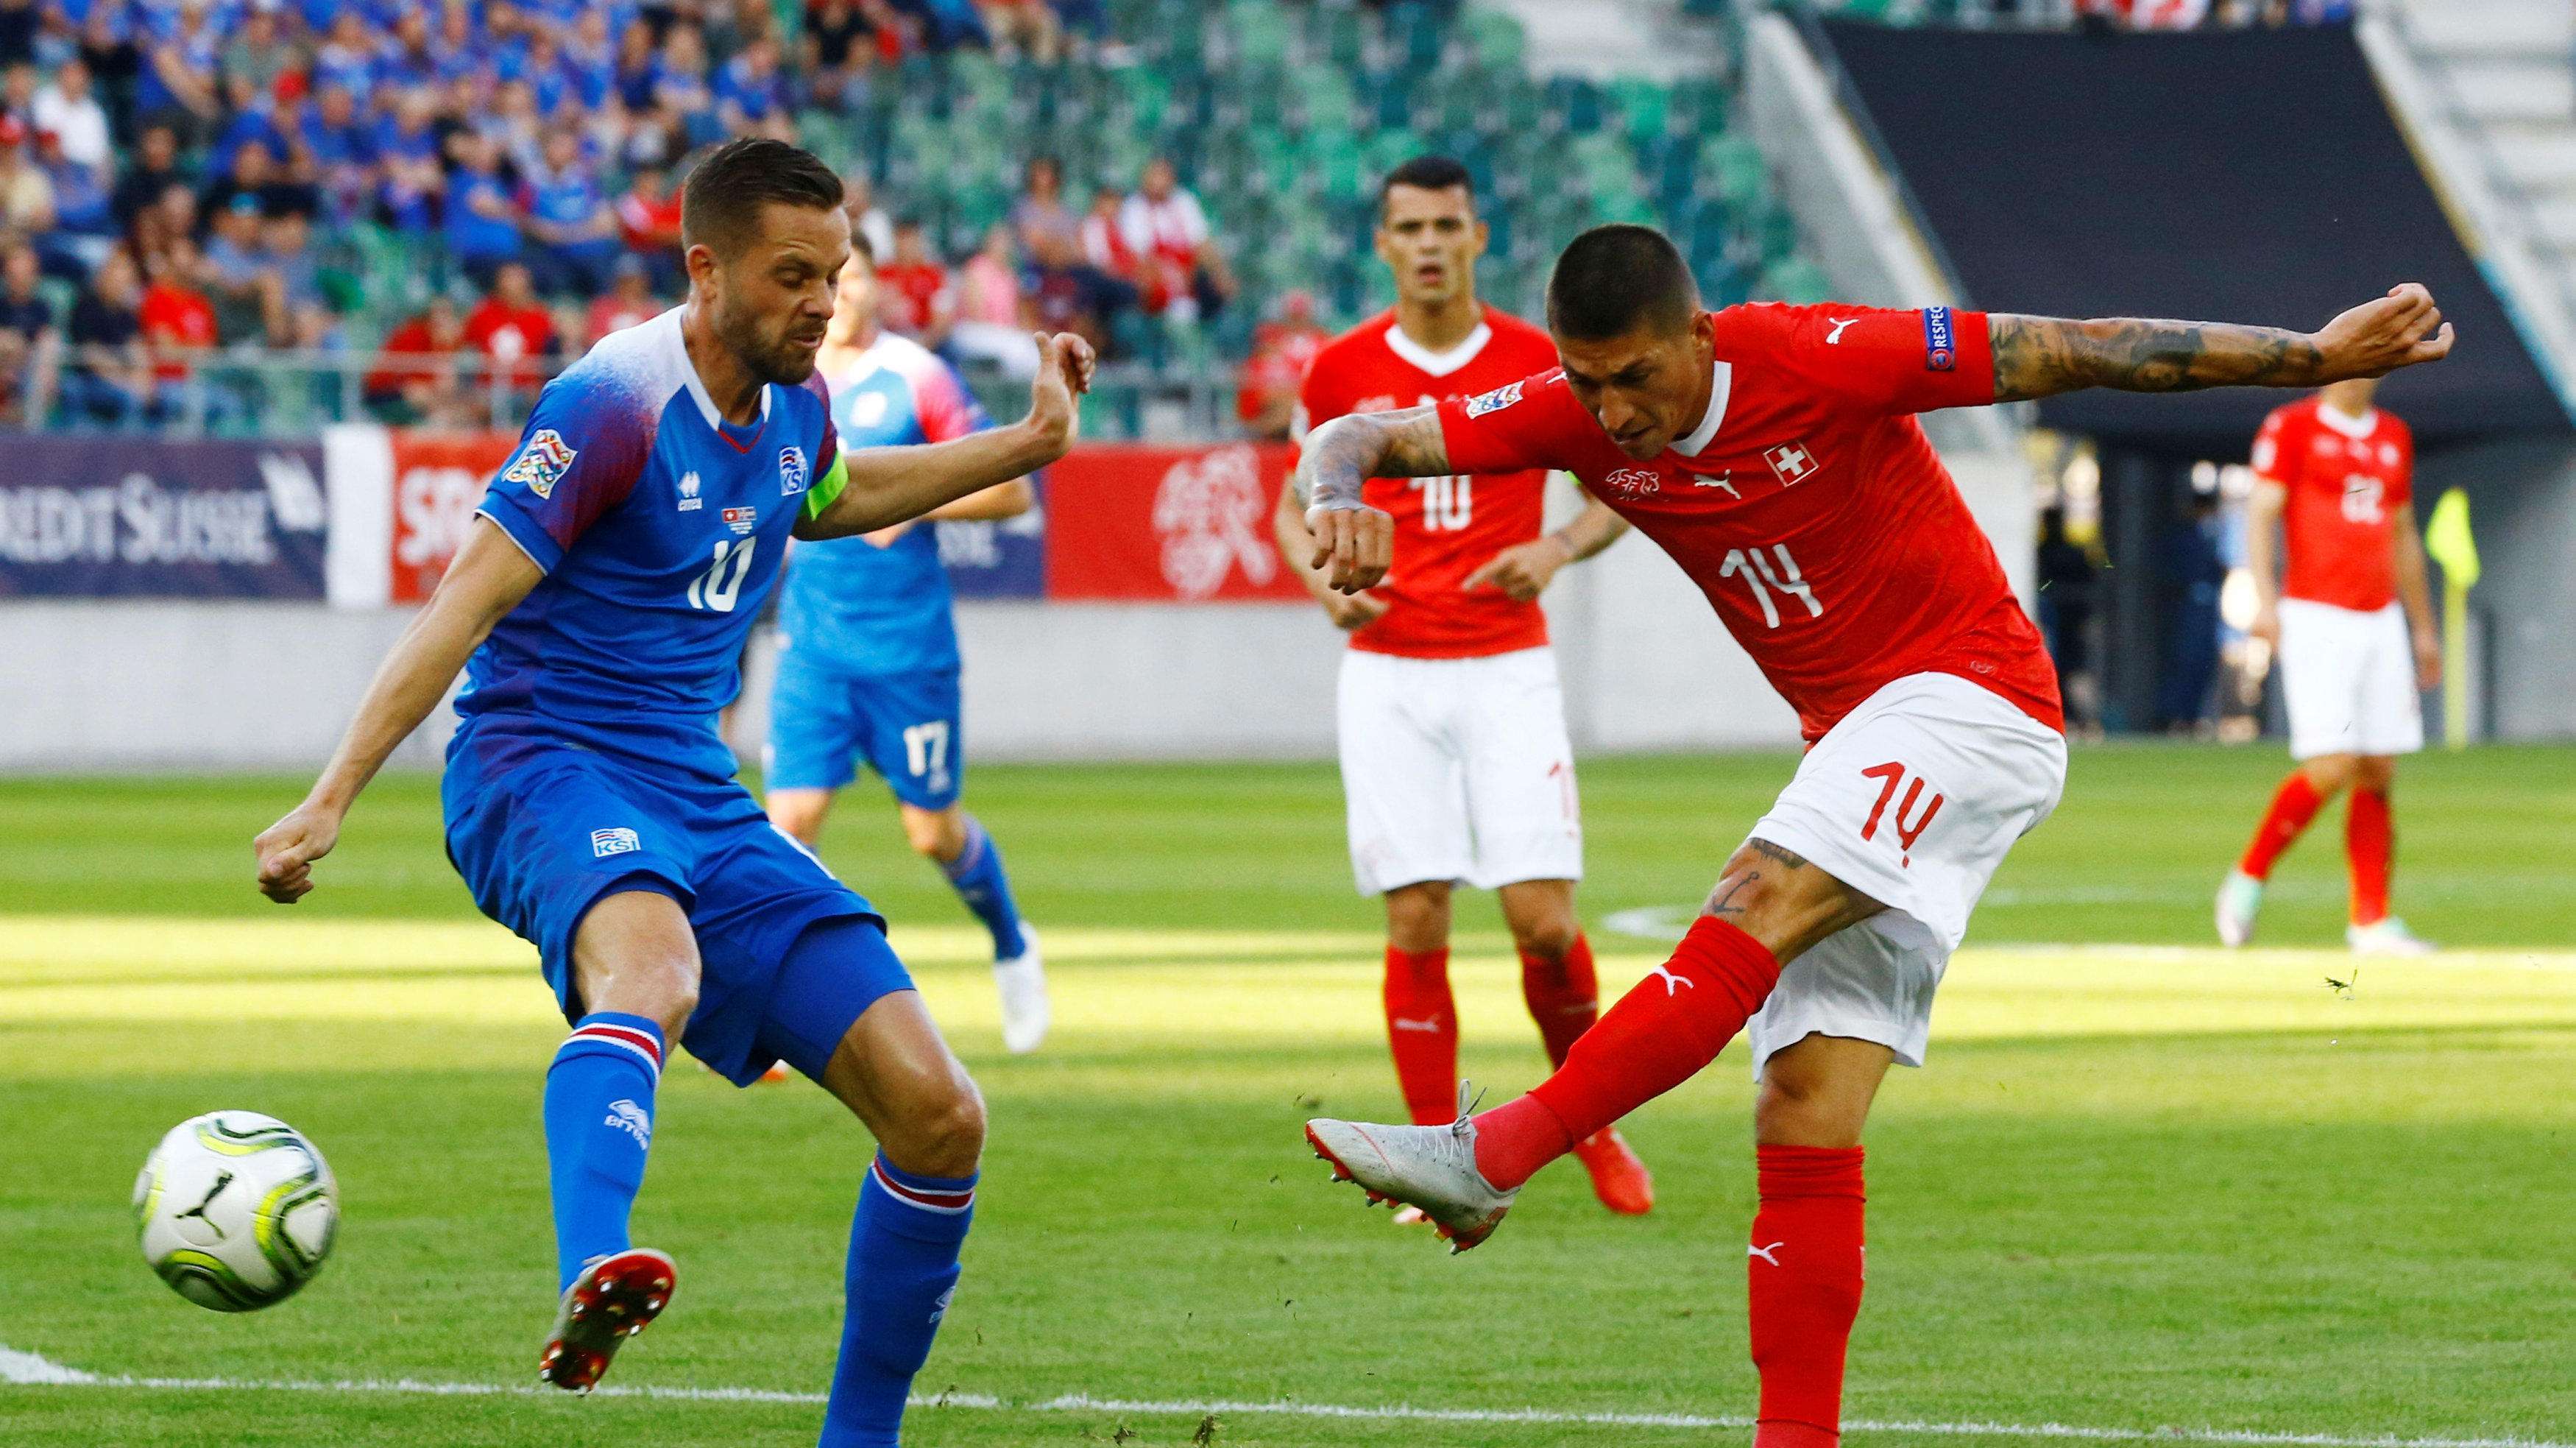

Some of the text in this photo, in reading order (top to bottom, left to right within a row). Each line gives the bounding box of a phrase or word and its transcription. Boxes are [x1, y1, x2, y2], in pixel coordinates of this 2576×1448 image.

[1409, 474, 1471, 531] 10
[687, 536, 757, 612] 10
[1719, 544, 1824, 629] 14
[903, 719, 950, 794] 17
[1861, 761, 1944, 869] 14
